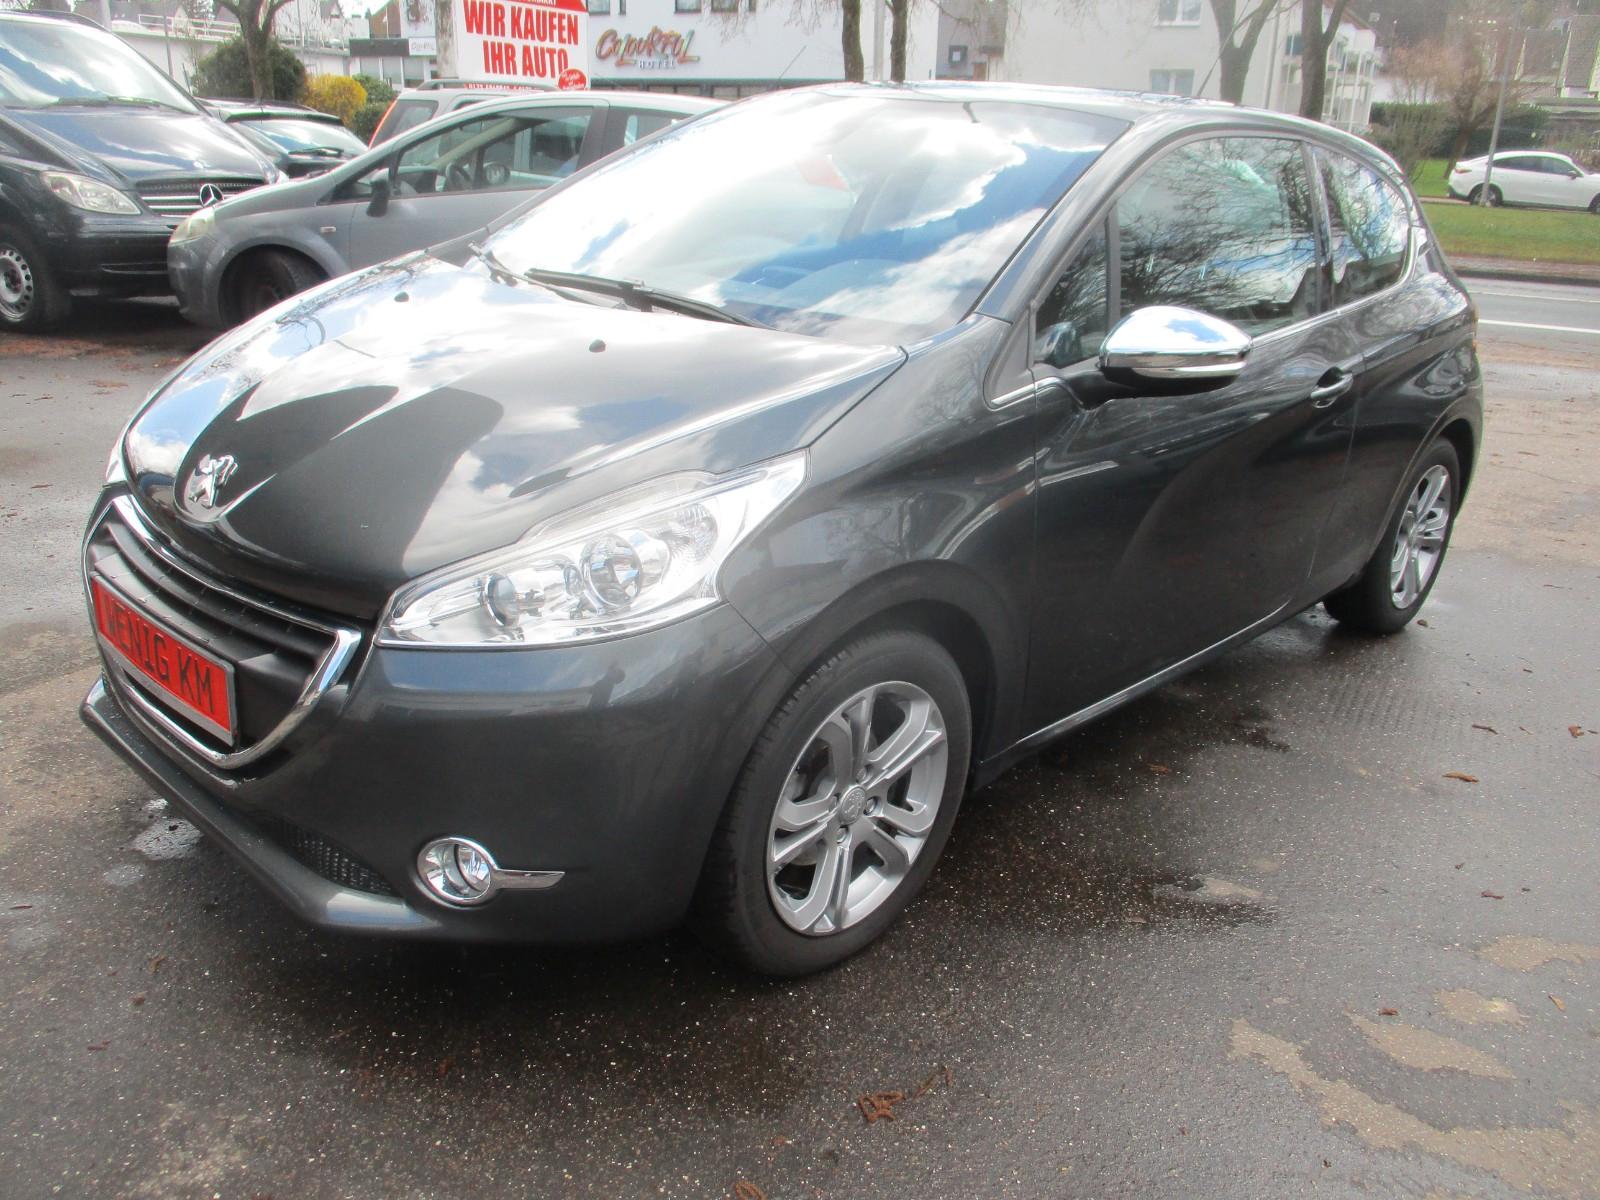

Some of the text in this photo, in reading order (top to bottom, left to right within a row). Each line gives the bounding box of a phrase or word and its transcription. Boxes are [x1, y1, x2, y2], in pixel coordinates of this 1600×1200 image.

[463, 0, 579, 46] WIR KAUFEN
[483, 40, 569, 79] IHR AUTO
[638, 59, 676, 70] HOTEL
[103, 594, 214, 714] WENIG KM
